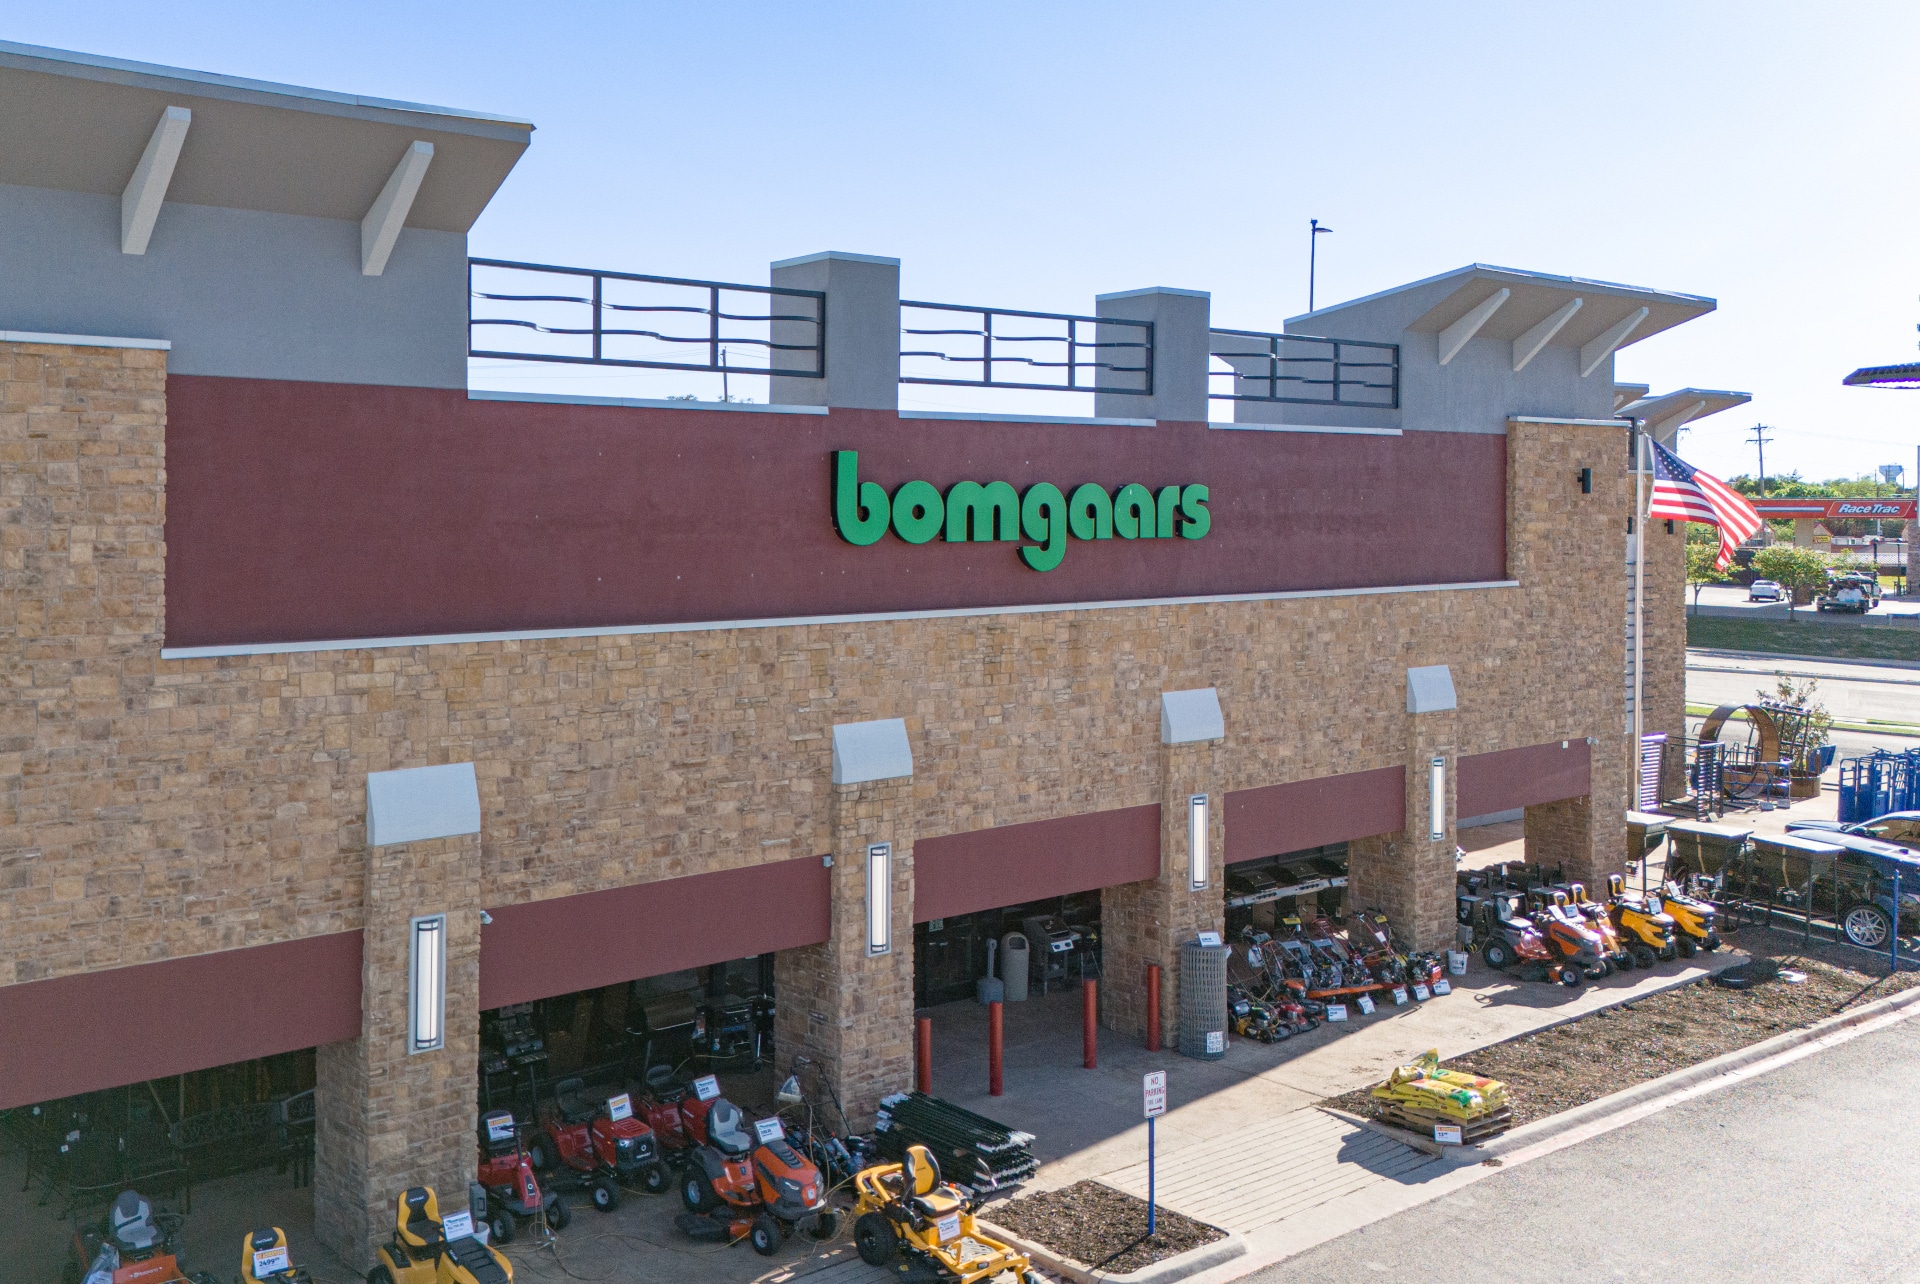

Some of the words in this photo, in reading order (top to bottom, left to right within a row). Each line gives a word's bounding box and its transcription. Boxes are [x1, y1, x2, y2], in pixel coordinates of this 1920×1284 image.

[831, 450, 1211, 572] bomgaars
[1838, 503, 1900, 515] RaceTrac
[1150, 1076, 1159, 1086] NO
[1145, 1086, 1165, 1098] PARKING
